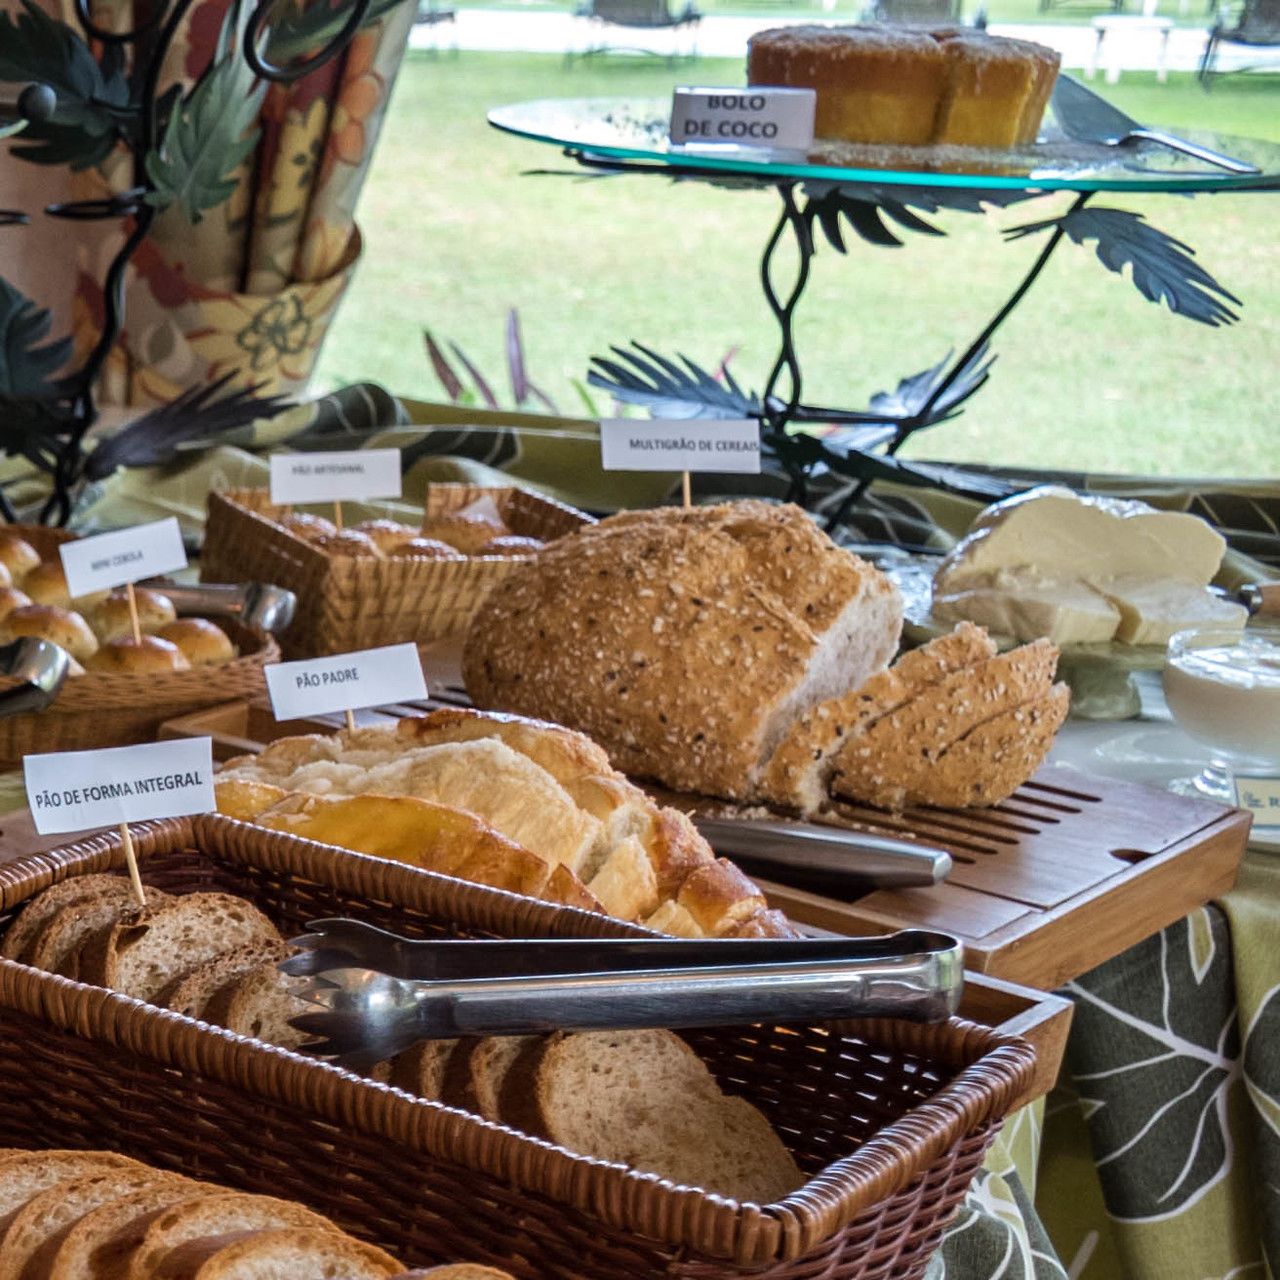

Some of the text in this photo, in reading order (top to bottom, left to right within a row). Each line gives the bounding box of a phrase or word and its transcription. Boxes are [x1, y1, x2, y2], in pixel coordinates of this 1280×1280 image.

[707, 95, 766, 111] BOLO
[684, 119, 778, 139] DE COCO
[630, 437, 696, 450] MULTIGRÃO
[699, 440, 712, 451] DE
[296, 668, 359, 688] PÃO PADRE
[35, 771, 202, 808] PÃO DE FORMA INTEGRAL
